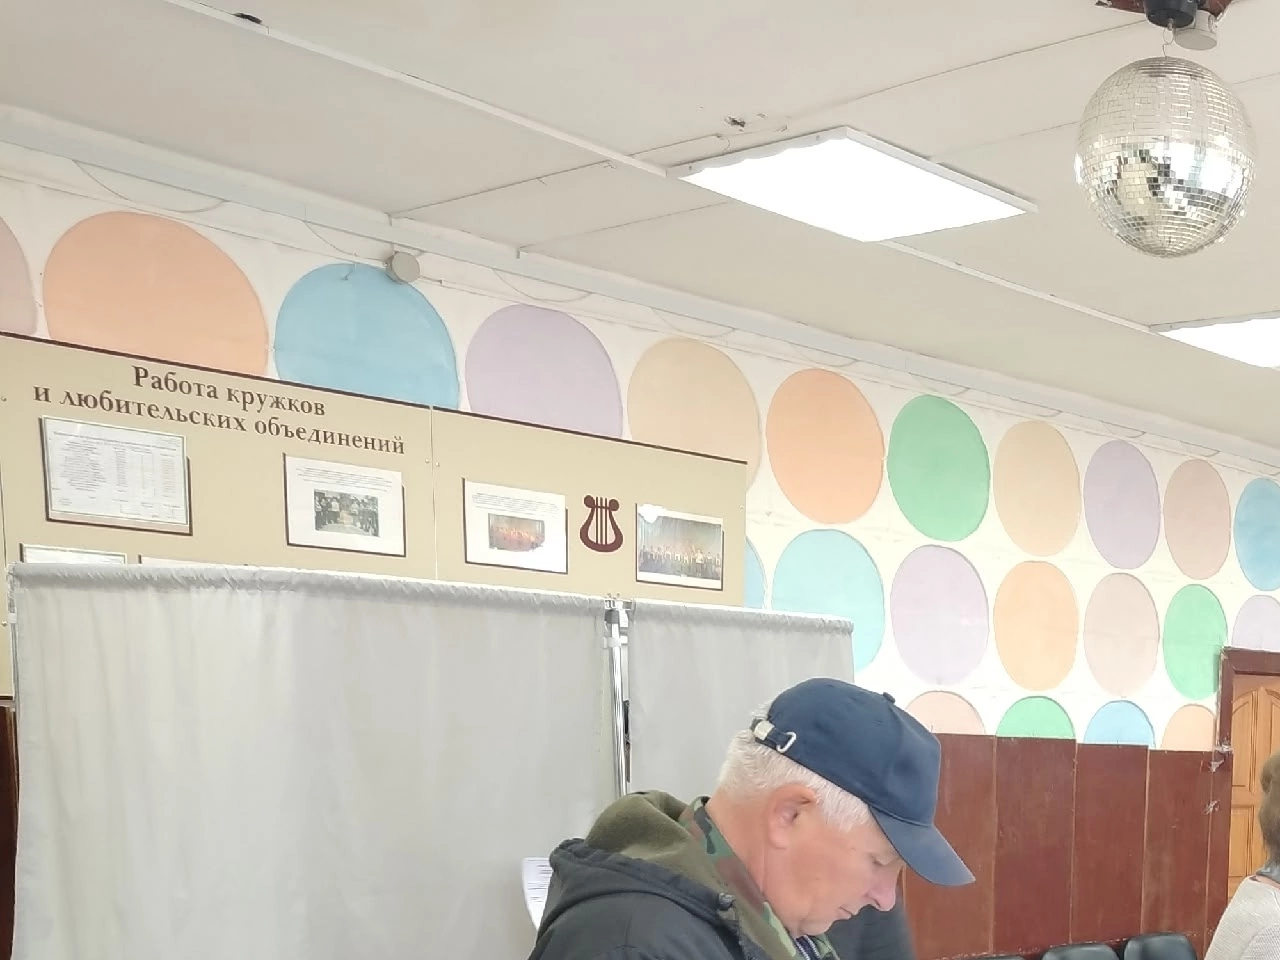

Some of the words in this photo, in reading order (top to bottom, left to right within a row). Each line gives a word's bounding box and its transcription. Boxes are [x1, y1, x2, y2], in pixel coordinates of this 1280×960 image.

[33, 386, 51, 403] и
[60, 390, 247, 432] любительских
[254, 416, 405, 455] объединений
[131, 365, 219, 399] Работа
[226, 387, 326, 416] кружков
